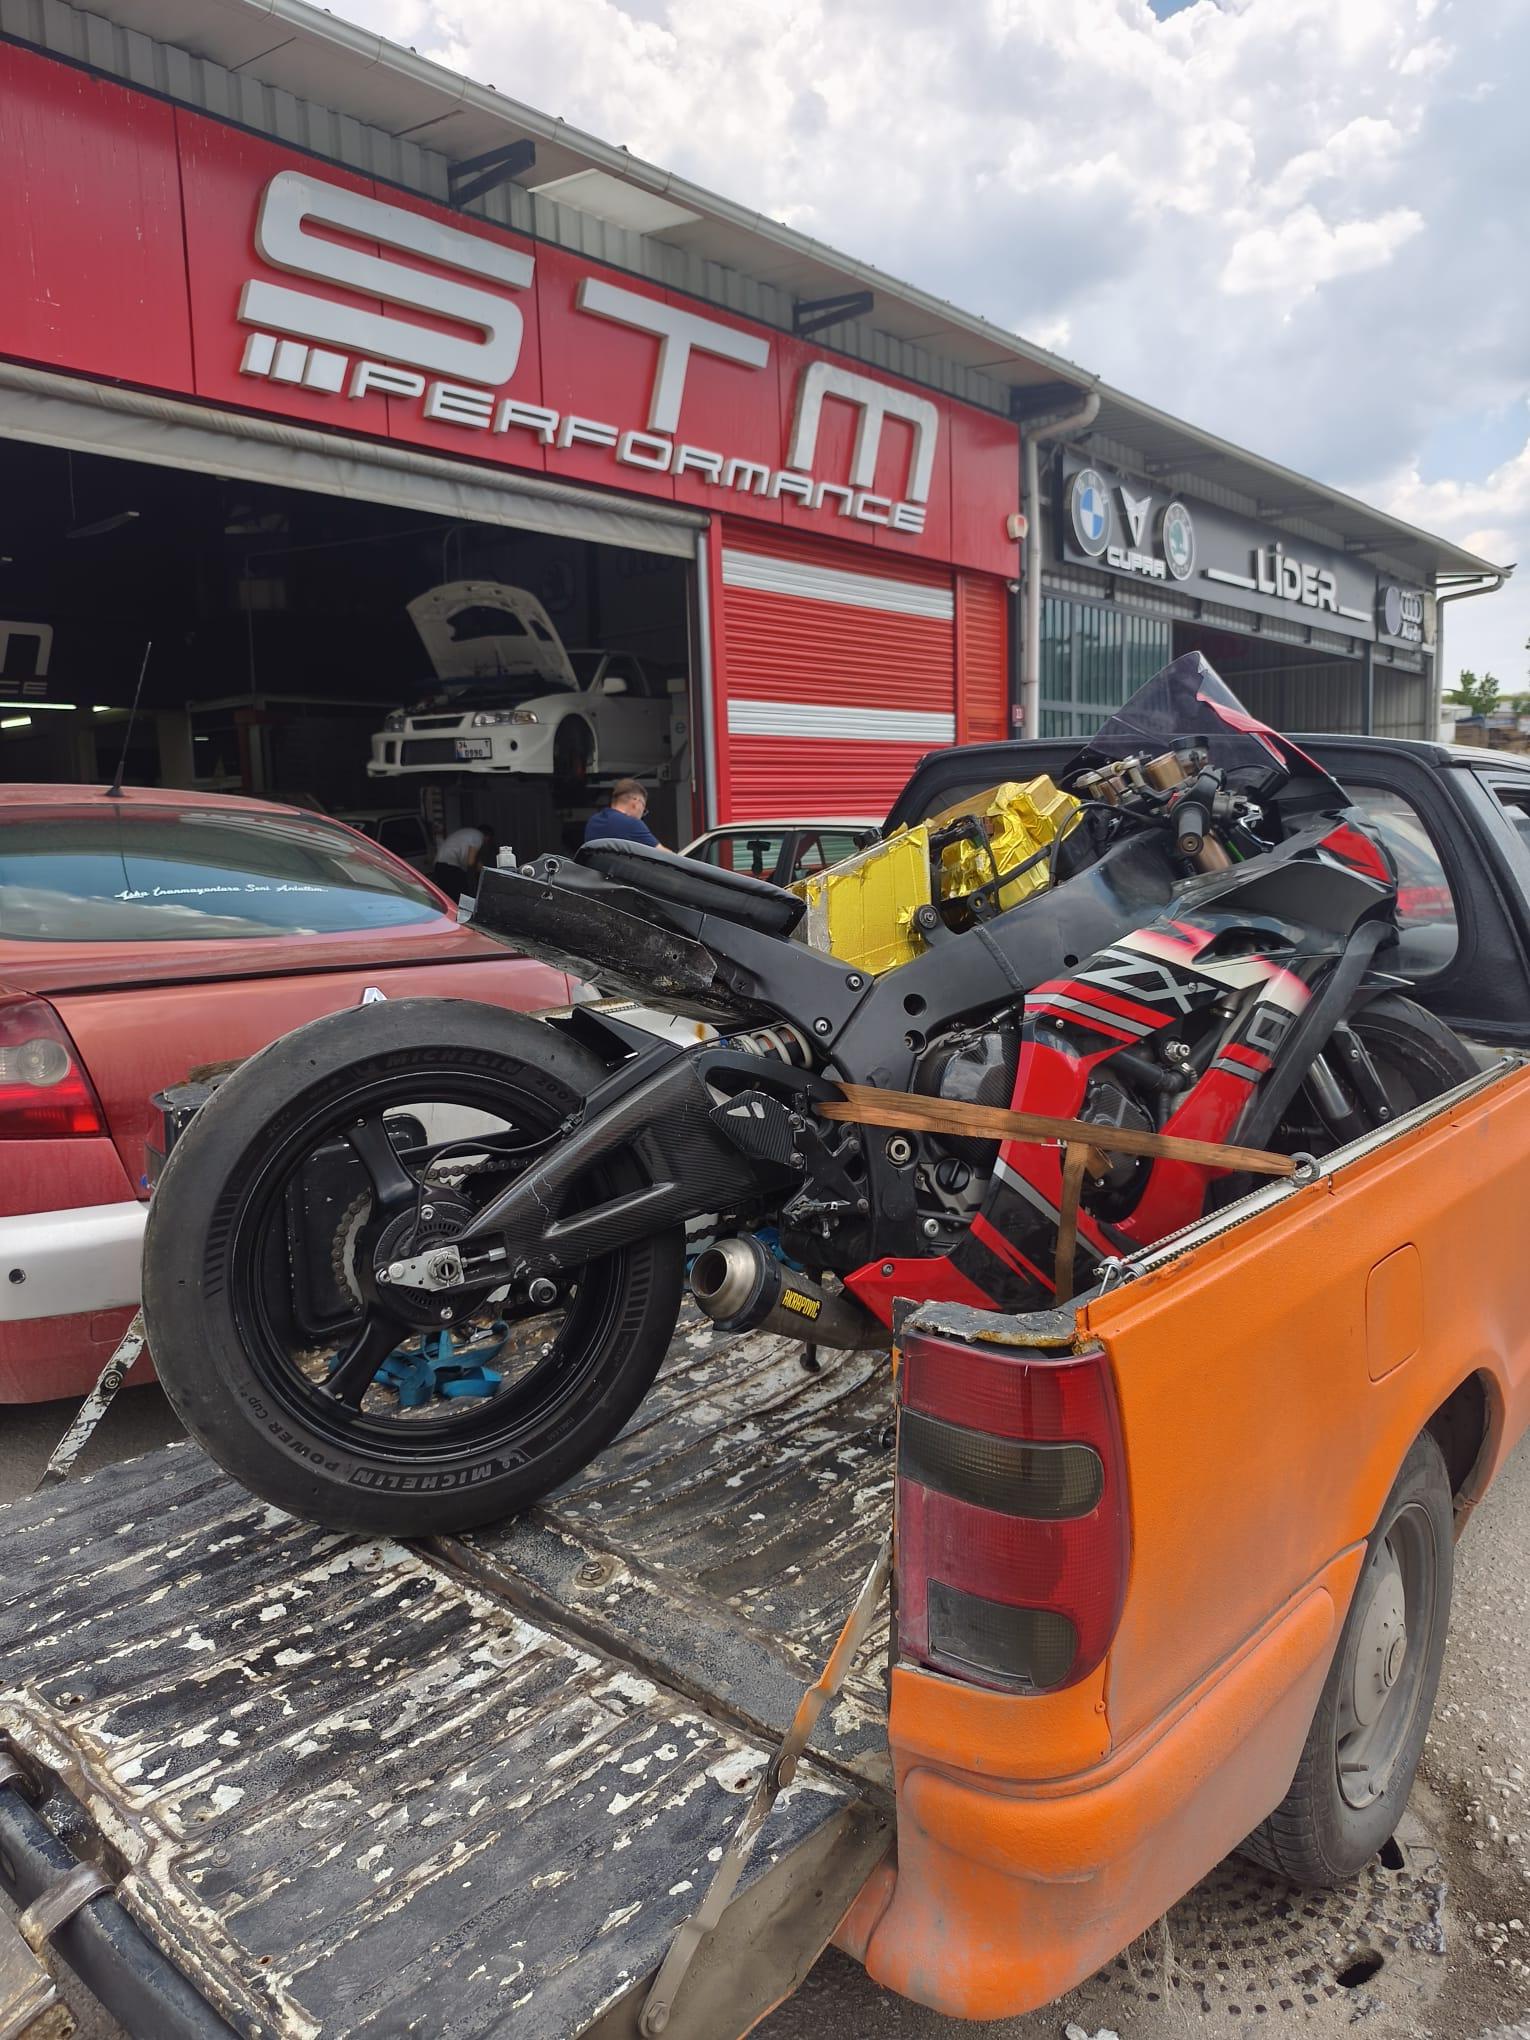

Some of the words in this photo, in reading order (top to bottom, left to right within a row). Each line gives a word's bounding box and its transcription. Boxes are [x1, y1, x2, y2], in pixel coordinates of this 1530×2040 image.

[238, 170, 939, 503] STM
[349, 361, 928, 534] PERFORMANCE
[1107, 545, 1166, 580] CUPRA
[1257, 541, 1339, 613] LİDER
[244, 883, 272, 893] Seni
[386, 1048, 523, 1075] MICHELIN
[268, 1421, 341, 1473] POWER
[354, 1462, 493, 1490] MICHELIN
